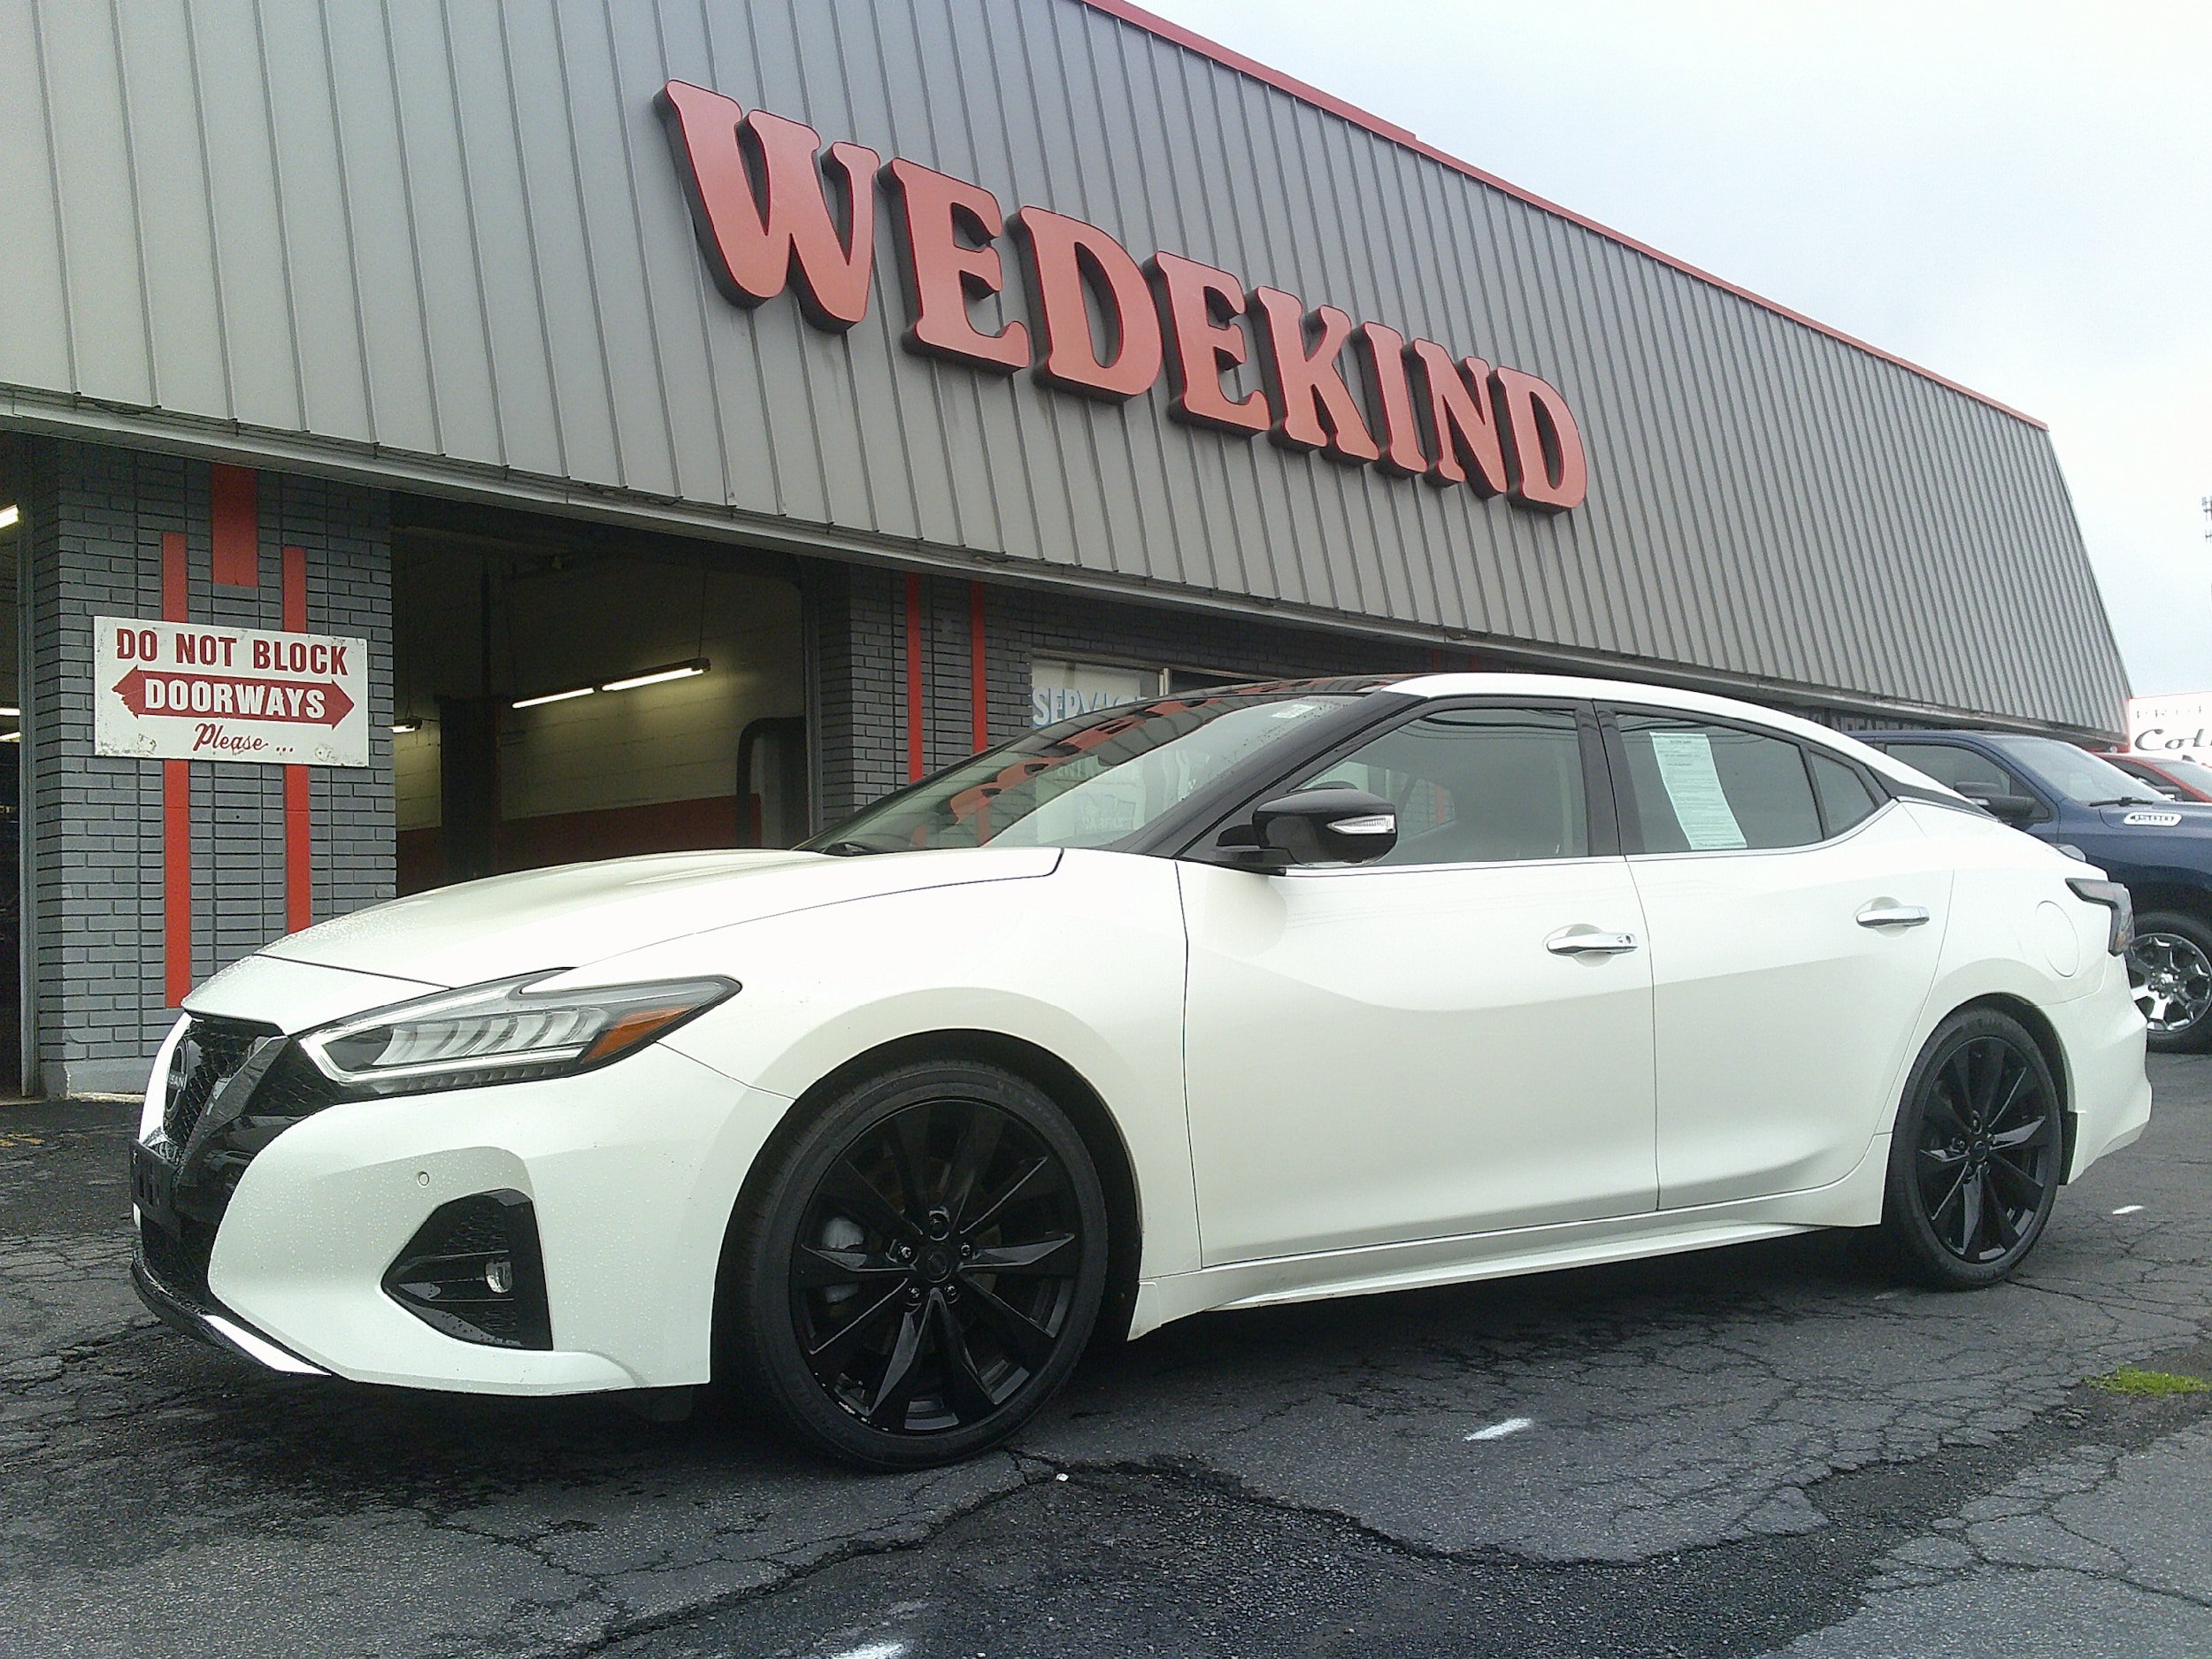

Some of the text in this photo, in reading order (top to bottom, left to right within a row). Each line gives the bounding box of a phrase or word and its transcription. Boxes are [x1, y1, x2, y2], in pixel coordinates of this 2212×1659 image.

[654, 79, 1587, 513] WEDEKIND
[116, 627, 348, 676] DO NOT BLOCK
[144, 678, 326, 719] DOORWAYS
